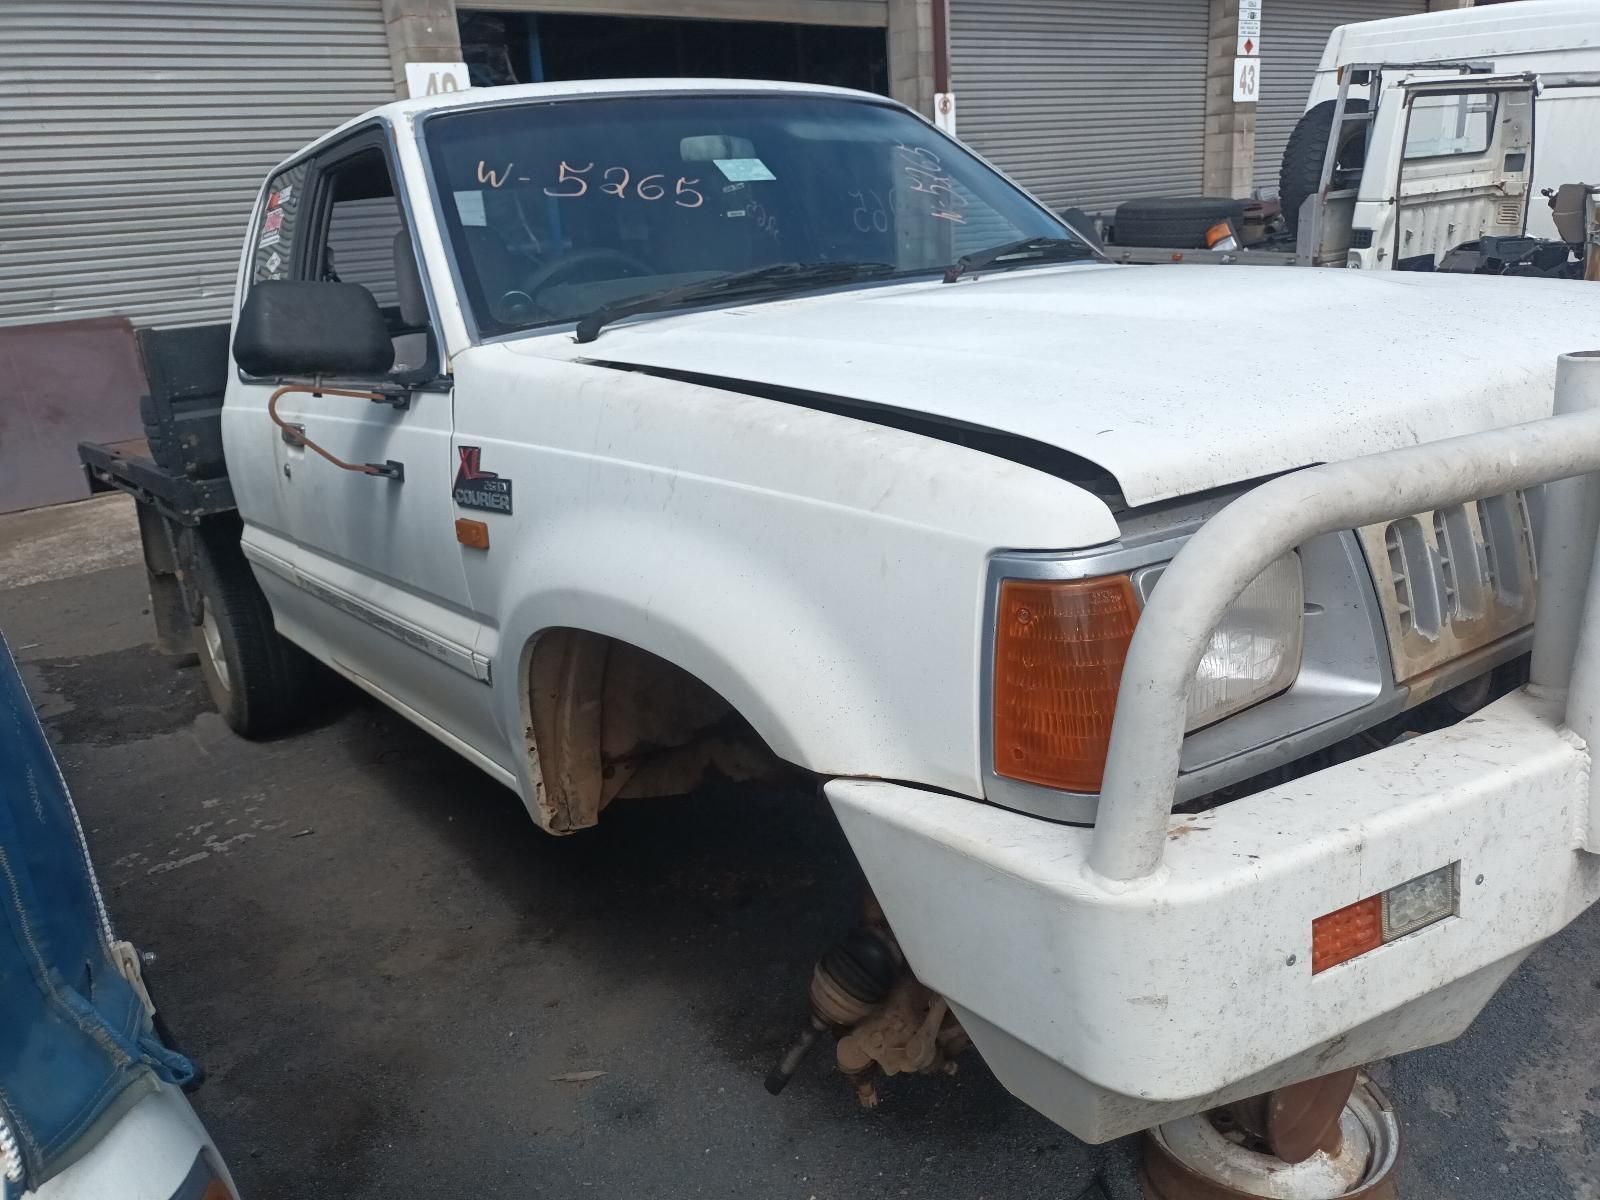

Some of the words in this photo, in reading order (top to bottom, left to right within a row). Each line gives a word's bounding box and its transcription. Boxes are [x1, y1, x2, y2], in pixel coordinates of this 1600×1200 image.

[1239, 64, 1256, 96] 43
[459, 446, 498, 481] XL
[455, 487, 511, 511] COURIER
